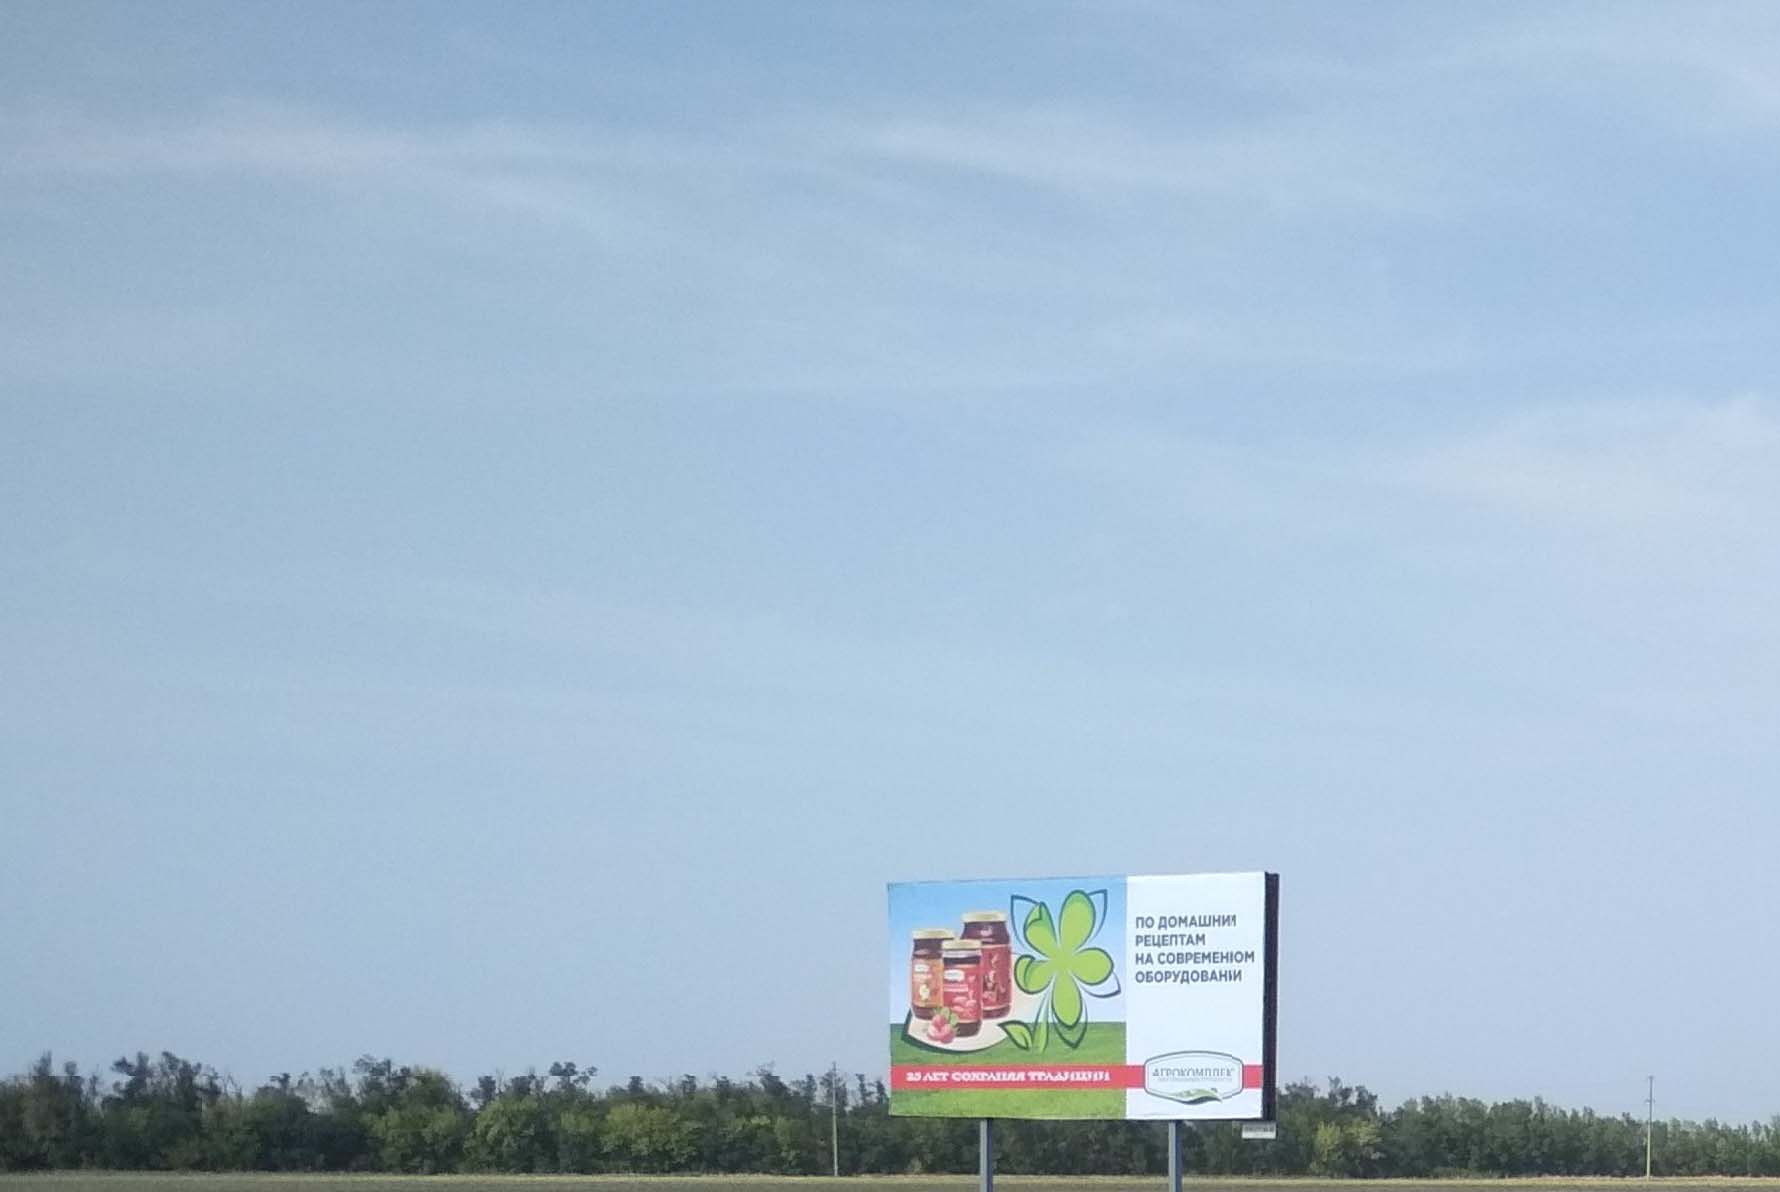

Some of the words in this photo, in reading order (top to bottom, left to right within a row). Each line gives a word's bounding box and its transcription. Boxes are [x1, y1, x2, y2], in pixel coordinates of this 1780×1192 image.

[1136, 916, 1155, 929] ПО
[1135, 933, 1206, 948] РЕЦЕПТАМ
[1135, 952, 1154, 965] НА
[923, 1071, 949, 1082] ЛЕТ
[1152, 1067, 1236, 1077] АГРОКОМПЛЕК
